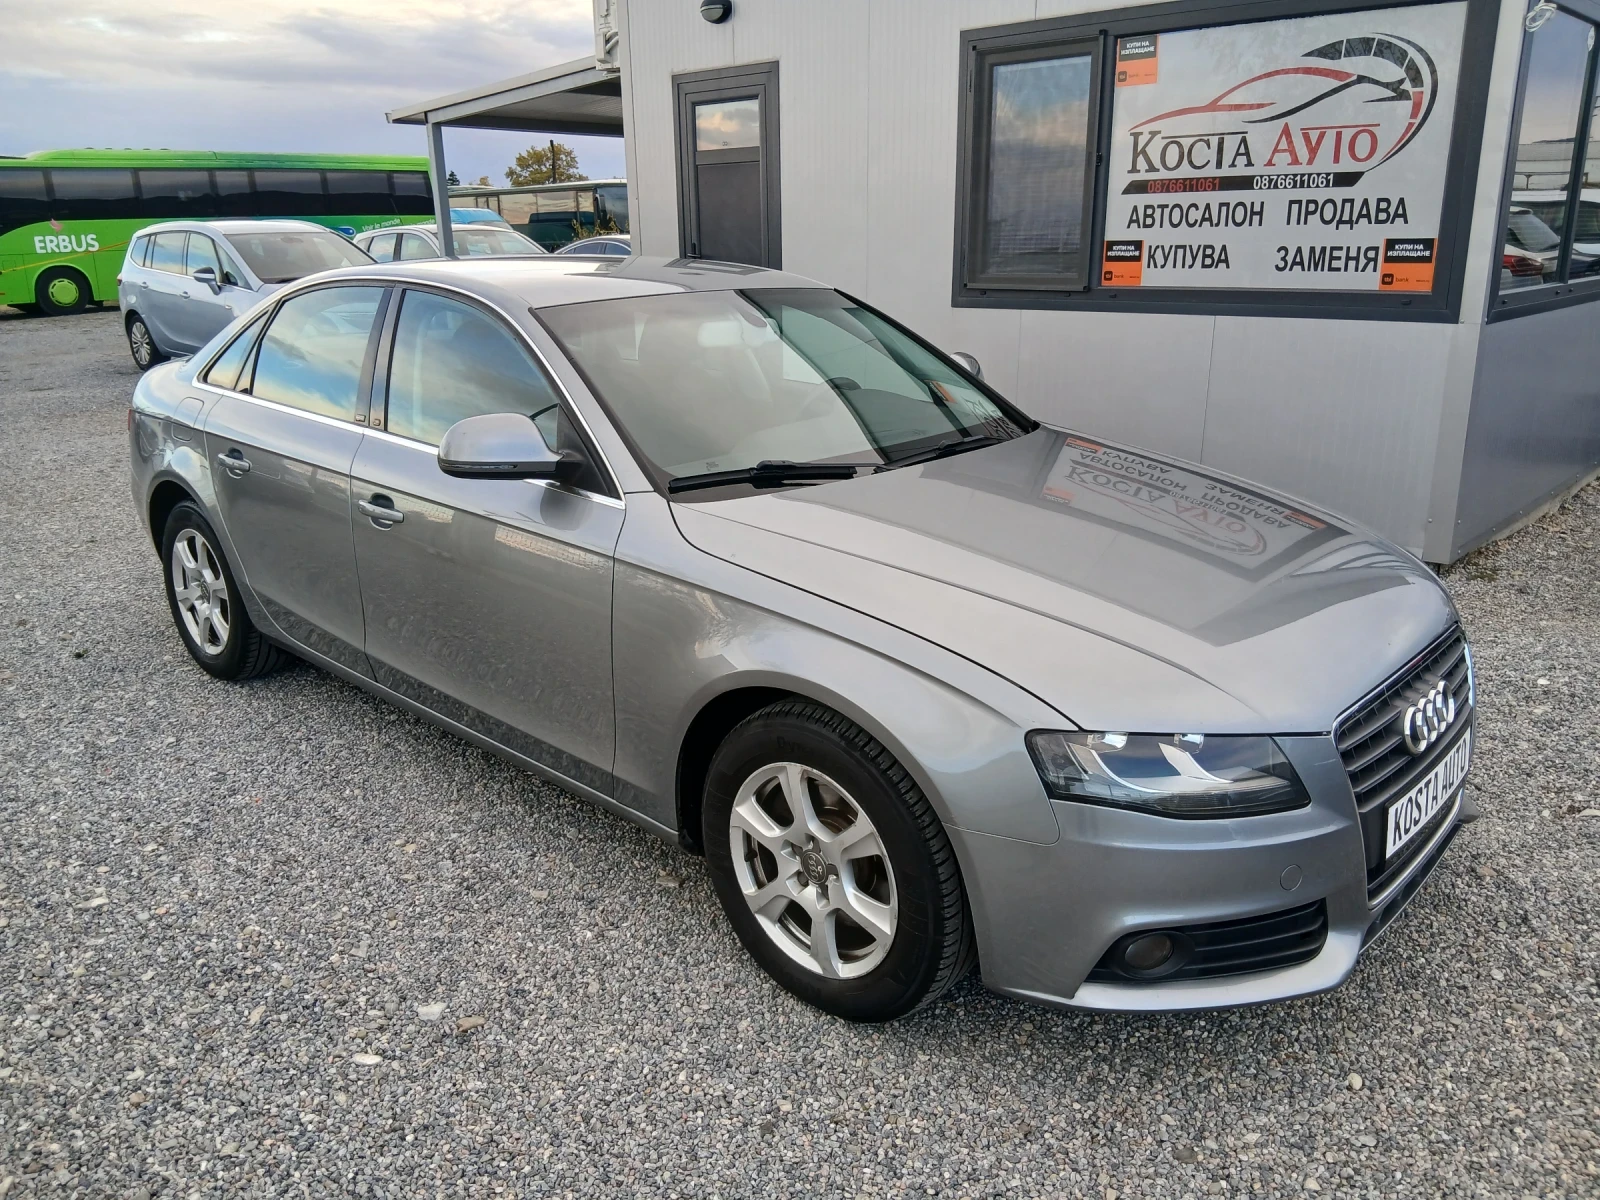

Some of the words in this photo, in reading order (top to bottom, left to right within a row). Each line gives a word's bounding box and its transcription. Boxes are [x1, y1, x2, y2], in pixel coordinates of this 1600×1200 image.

[1147, 178, 1220, 193] 0876611061
[1253, 173, 1334, 190] 0876611061
[1126, 201, 1265, 229] АВТОСАЛОН
[1286, 197, 1409, 230] ПРОДАВА
[34, 233, 100, 254] ERBUS
[1146, 244, 1230, 269] КУПУВА
[1274, 246, 1380, 272] ЗАМЕНЯ
[1393, 770, 1438, 847] KOSTA
[1441, 737, 1467, 800] AUTO
